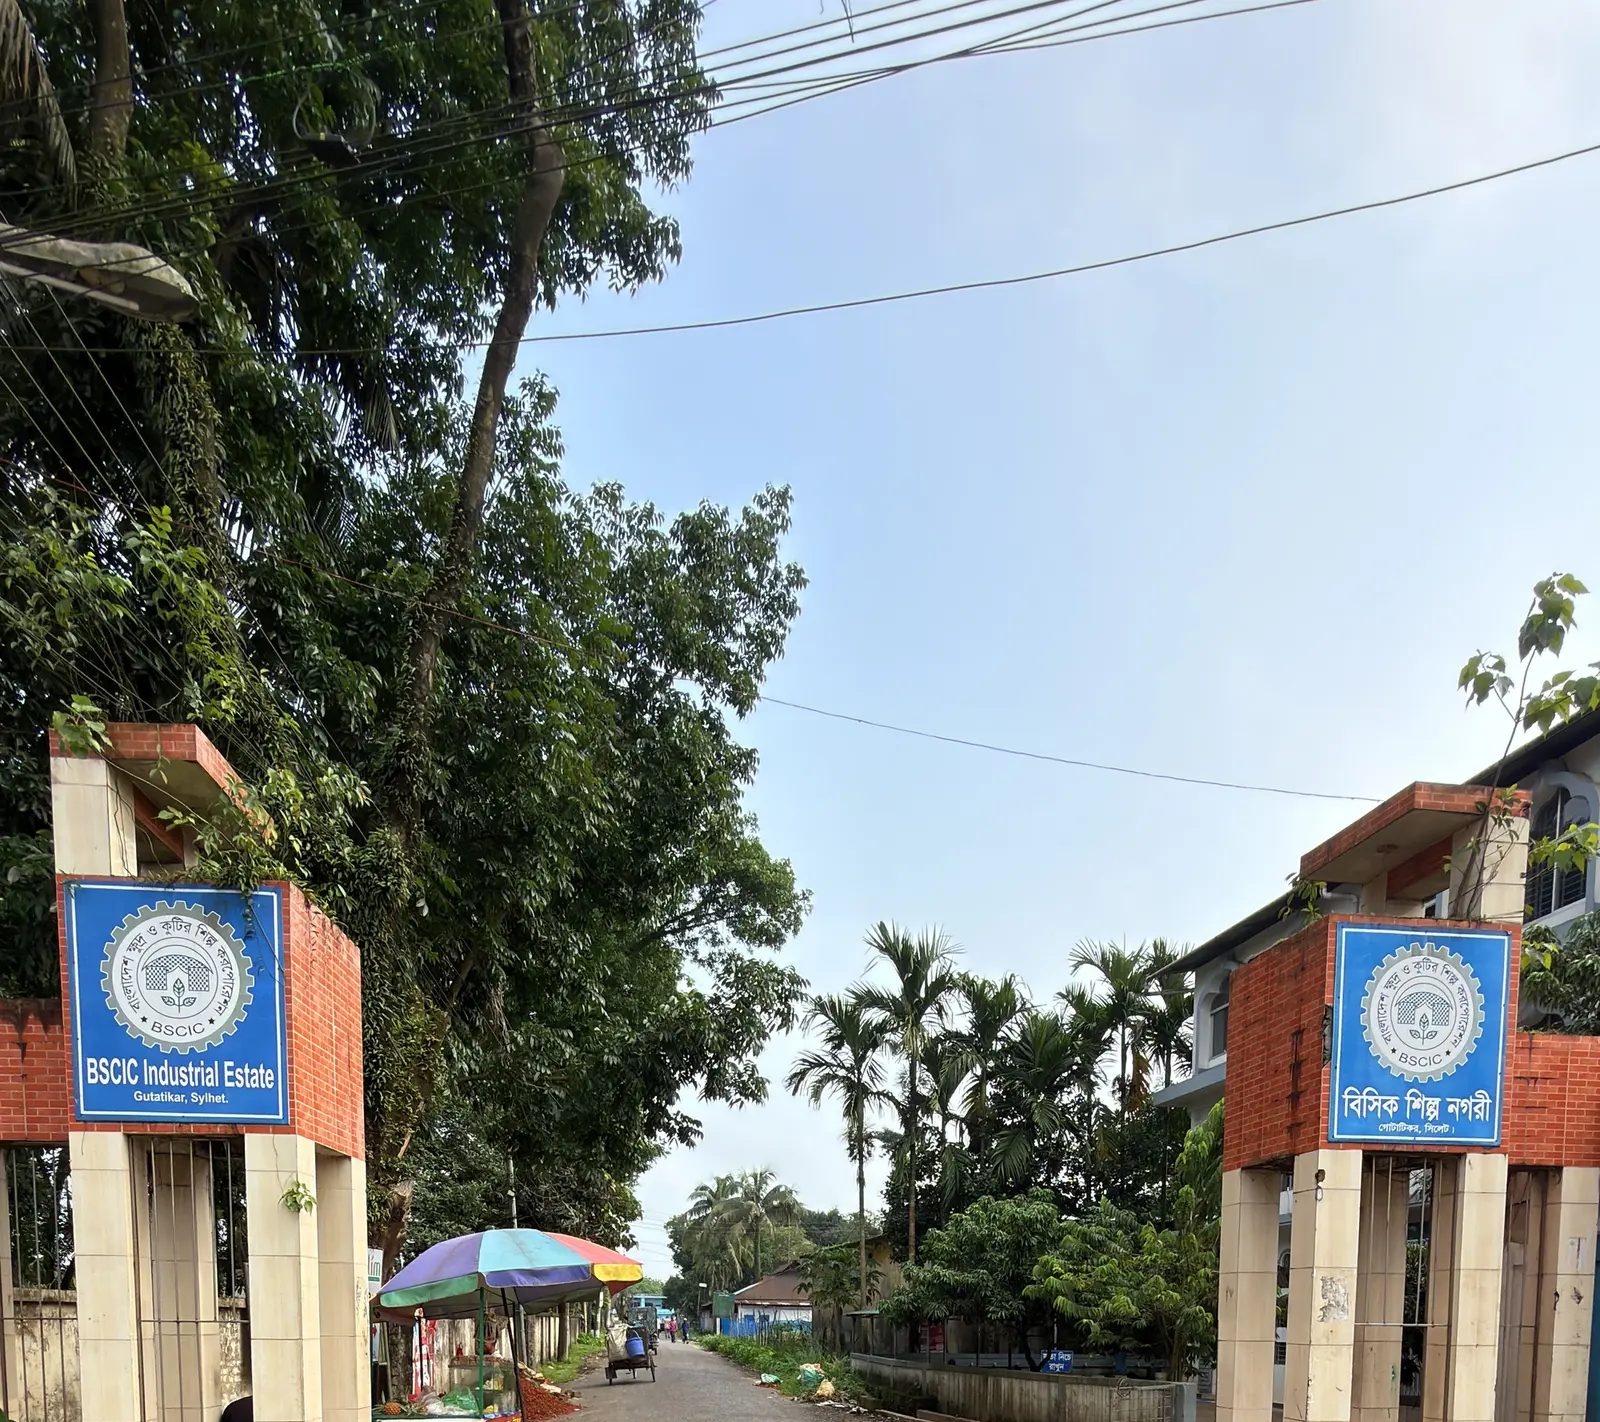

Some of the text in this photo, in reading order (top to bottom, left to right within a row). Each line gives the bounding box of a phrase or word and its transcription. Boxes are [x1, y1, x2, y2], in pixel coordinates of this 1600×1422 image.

[121, 917, 235, 1016] বাংলাদেশ ক্ষুদ্র ও কুটির শিল্প করপোরেশন
[1377, 992, 1392, 1045] বাংলাদেশ
[1401, 965, 1411, 974] ও
[1412, 957, 1439, 974] কুটির
[1440, 963, 1459, 986] শিল্প
[151, 1021, 206, 1037] BSCIC
[1398, 1052, 1443, 1067] BSCIC
[86, 1057, 275, 1088] BSCIC Industrial Estate
[133, 1090, 229, 1105] Gutatikar, Sylhet.
[1341, 1086, 1492, 1122] বিসিক শিল্প নগরী
[1378, 1121, 1422, 1134] গোটাটিকর,
